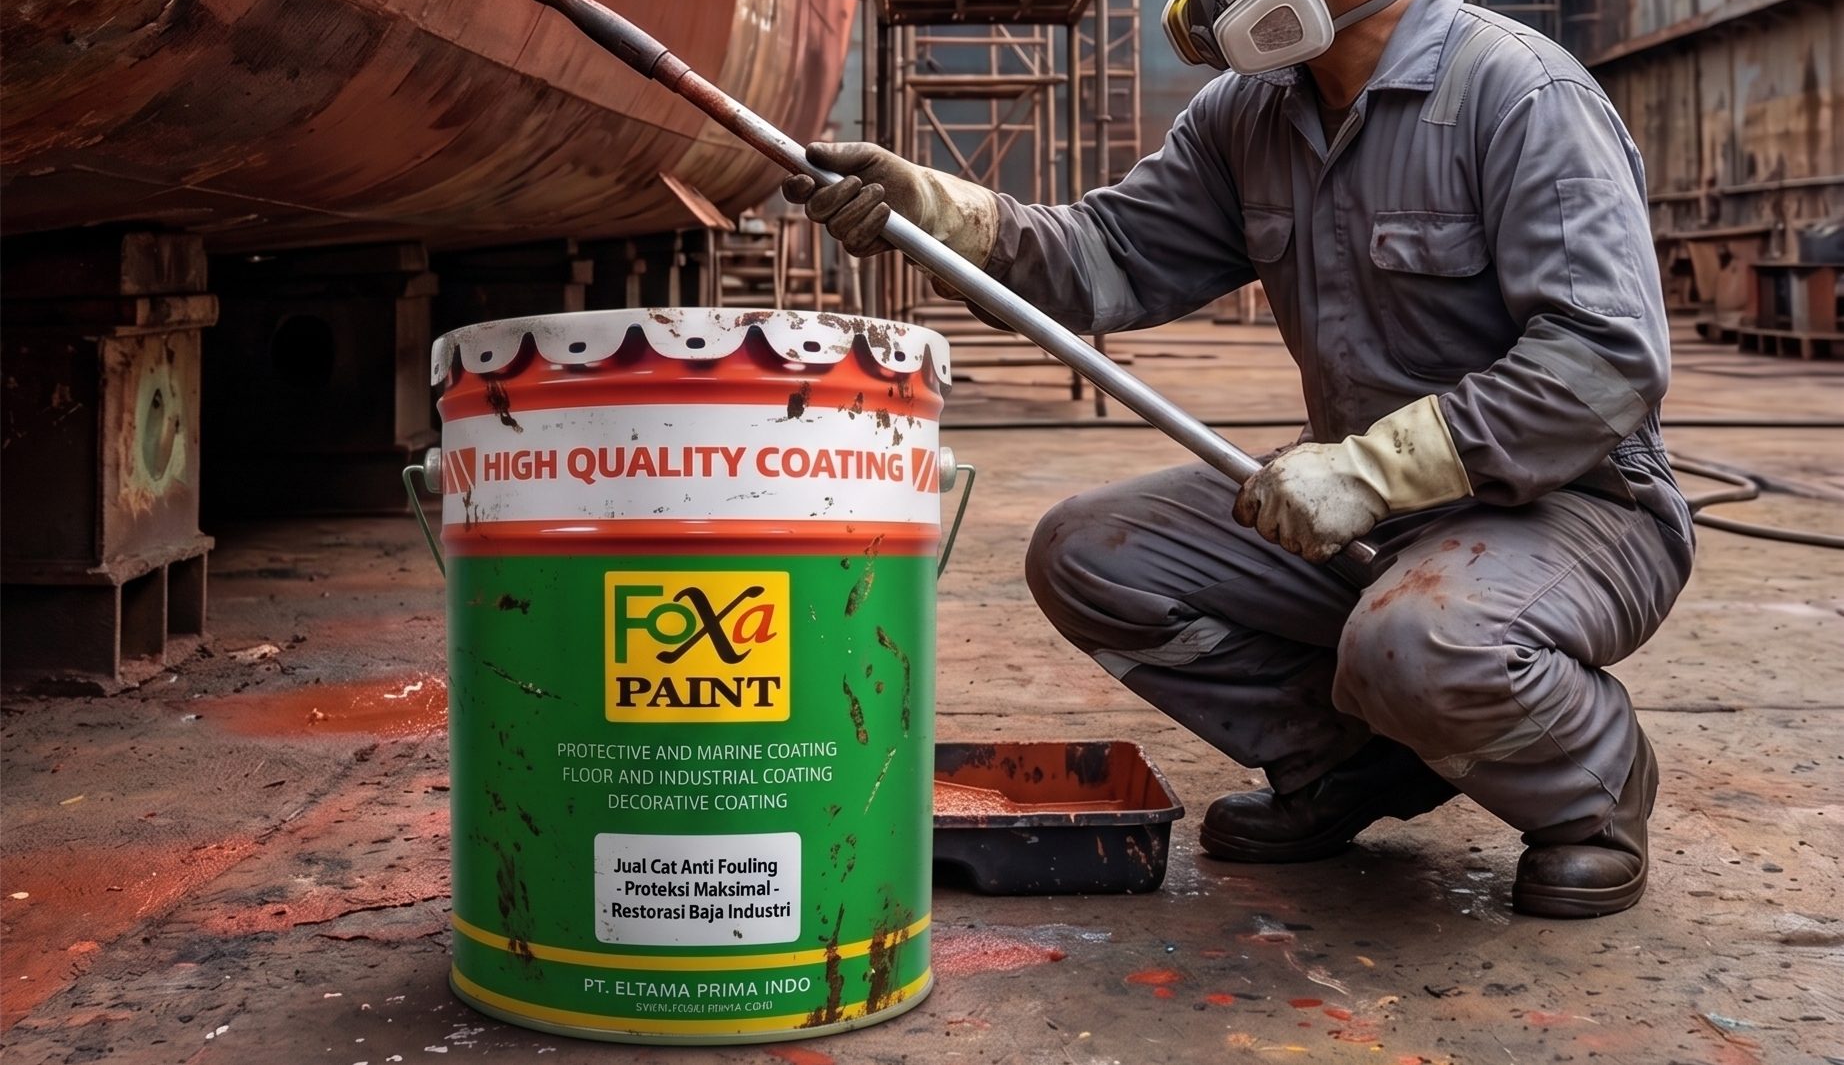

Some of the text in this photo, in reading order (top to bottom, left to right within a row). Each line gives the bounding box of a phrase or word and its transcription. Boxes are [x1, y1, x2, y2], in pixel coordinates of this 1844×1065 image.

[483, 447, 904, 485] HIGH QUALITY COATING
[616, 677, 781, 708] PAINT
[558, 742, 837, 760] PROTECTIVE AND MARINE COATING
[563, 766, 832, 785] FLOOR AND INDUSTRIAL COATING
[608, 793, 787, 810] DECORATIVE COATING
[614, 858, 777, 876] Jual Cat Anti Fouling
[625, 881, 689, 896] Proteksi
[694, 881, 770, 896] Maksimal
[612, 902, 790, 923] Restorasi Baja Industri
[584, 978, 810, 998] PT. ELTAMA PRIMA INDO
